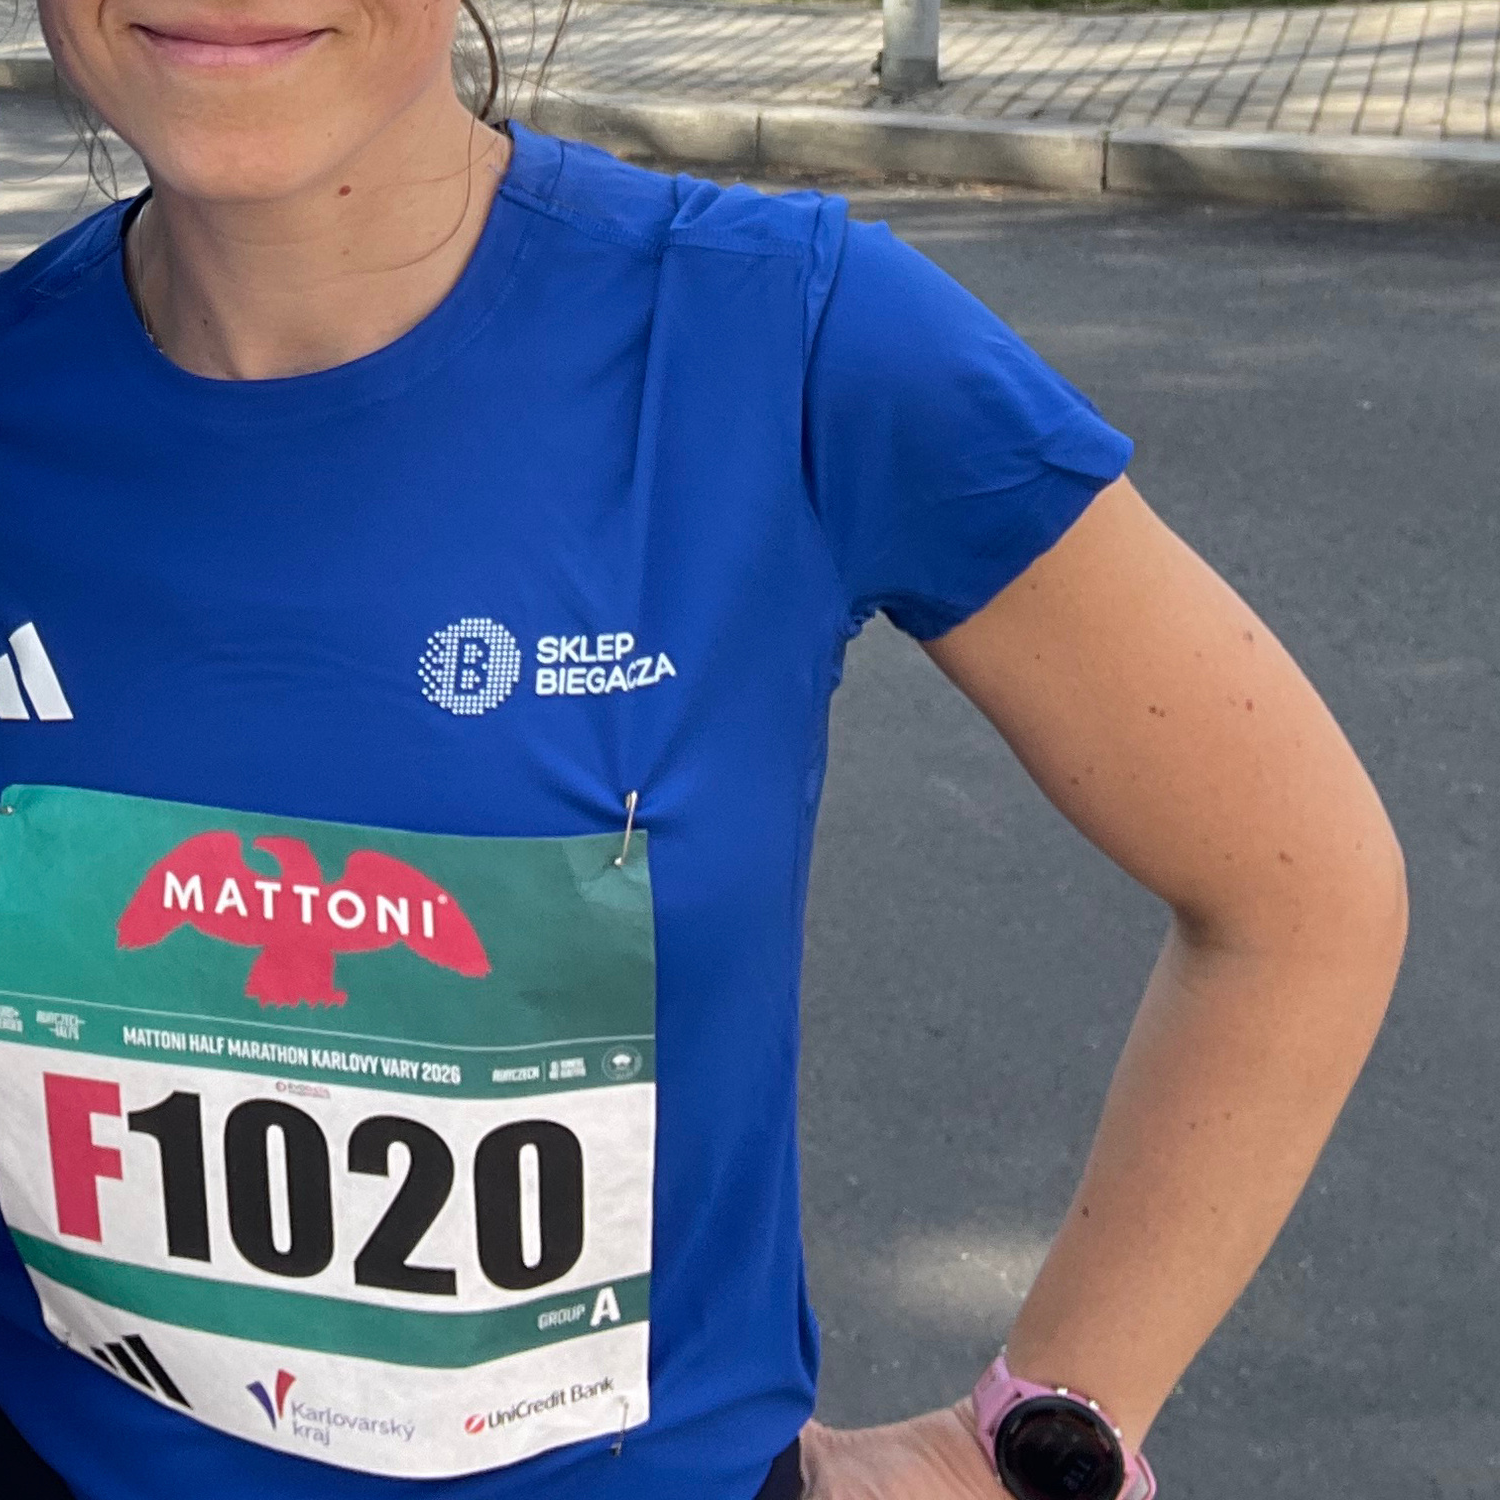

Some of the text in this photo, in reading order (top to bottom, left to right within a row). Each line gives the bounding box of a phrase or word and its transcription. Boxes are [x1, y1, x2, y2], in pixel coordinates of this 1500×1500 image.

[536, 632, 635, 664] SKLEP
[535, 652, 677, 696] BIEGACZA
[163, 871, 434, 939] MATTONI
[122, 1025, 462, 1086] MATTONI HALF MARATHON KARLOVY VARY 2026
[537, 1285, 621, 1330] GROUP A
[291, 1401, 416, 1442] Karlovarský
[488, 1375, 615, 1429] UniCredit Bank
[293, 1420, 331, 1447] kraj
